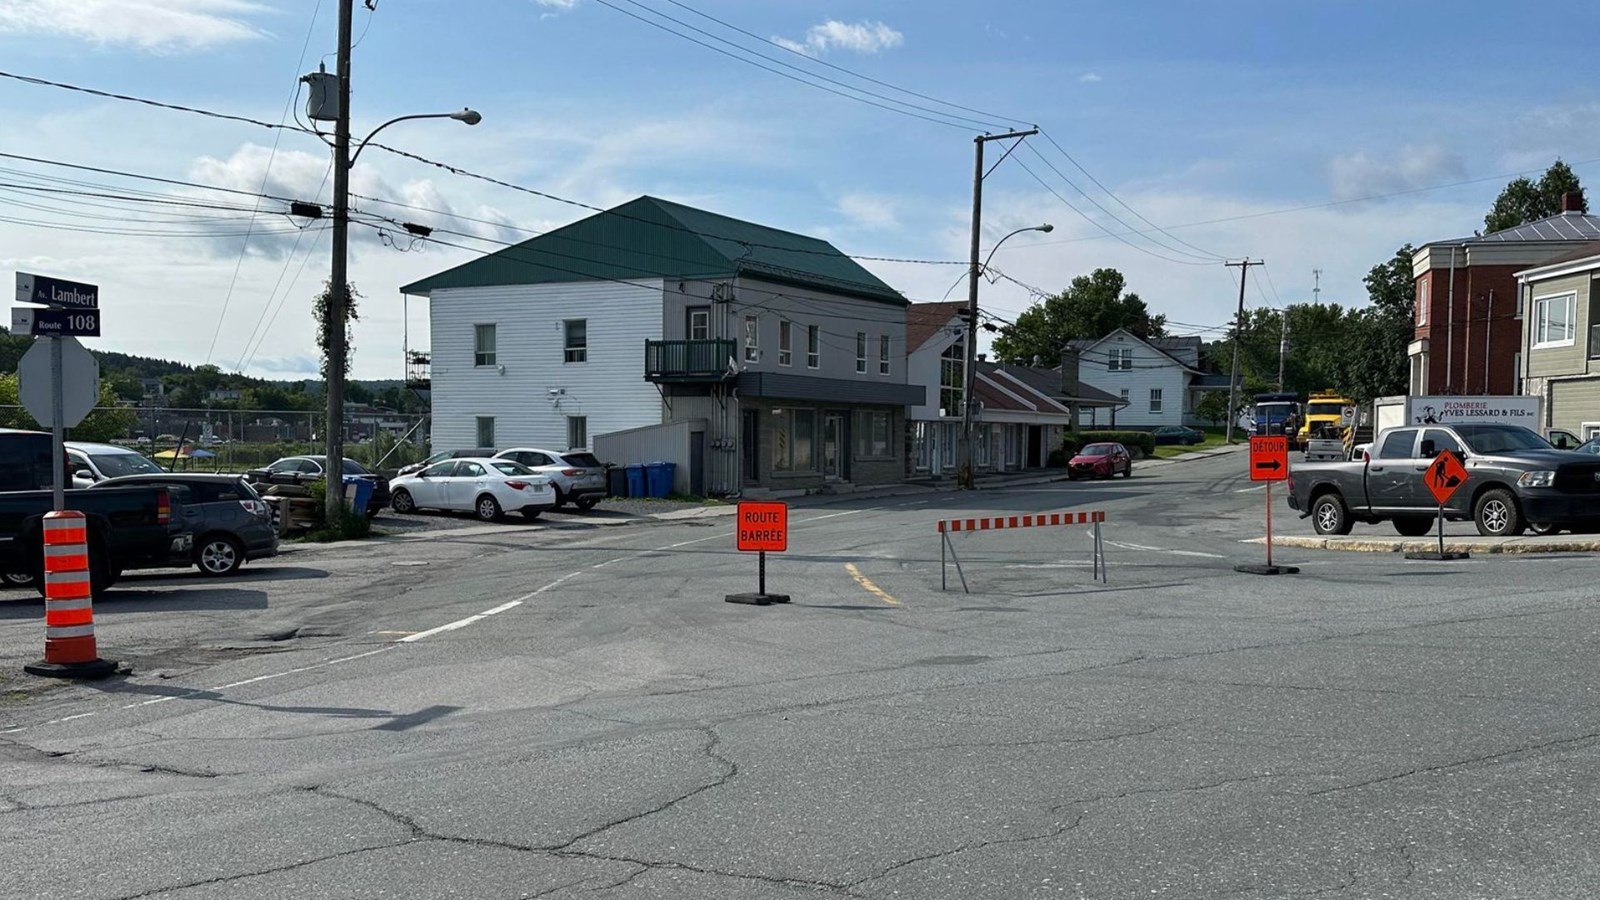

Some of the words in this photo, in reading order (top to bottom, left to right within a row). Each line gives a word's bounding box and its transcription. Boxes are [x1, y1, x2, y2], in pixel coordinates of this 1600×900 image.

[51, 285, 95, 307] Lambert
[39, 320, 62, 330] Route
[67, 314, 95, 331] 108
[1443, 409, 1464, 417] YVES
[1466, 409, 1500, 417] LESSARD
[1502, 409, 1507, 417] &
[1510, 409, 1525, 417] FILS
[1253, 439, 1285, 452] DÉTOUR
[745, 511, 779, 524] ROUTE
[741, 528, 783, 542] BARRÉE
